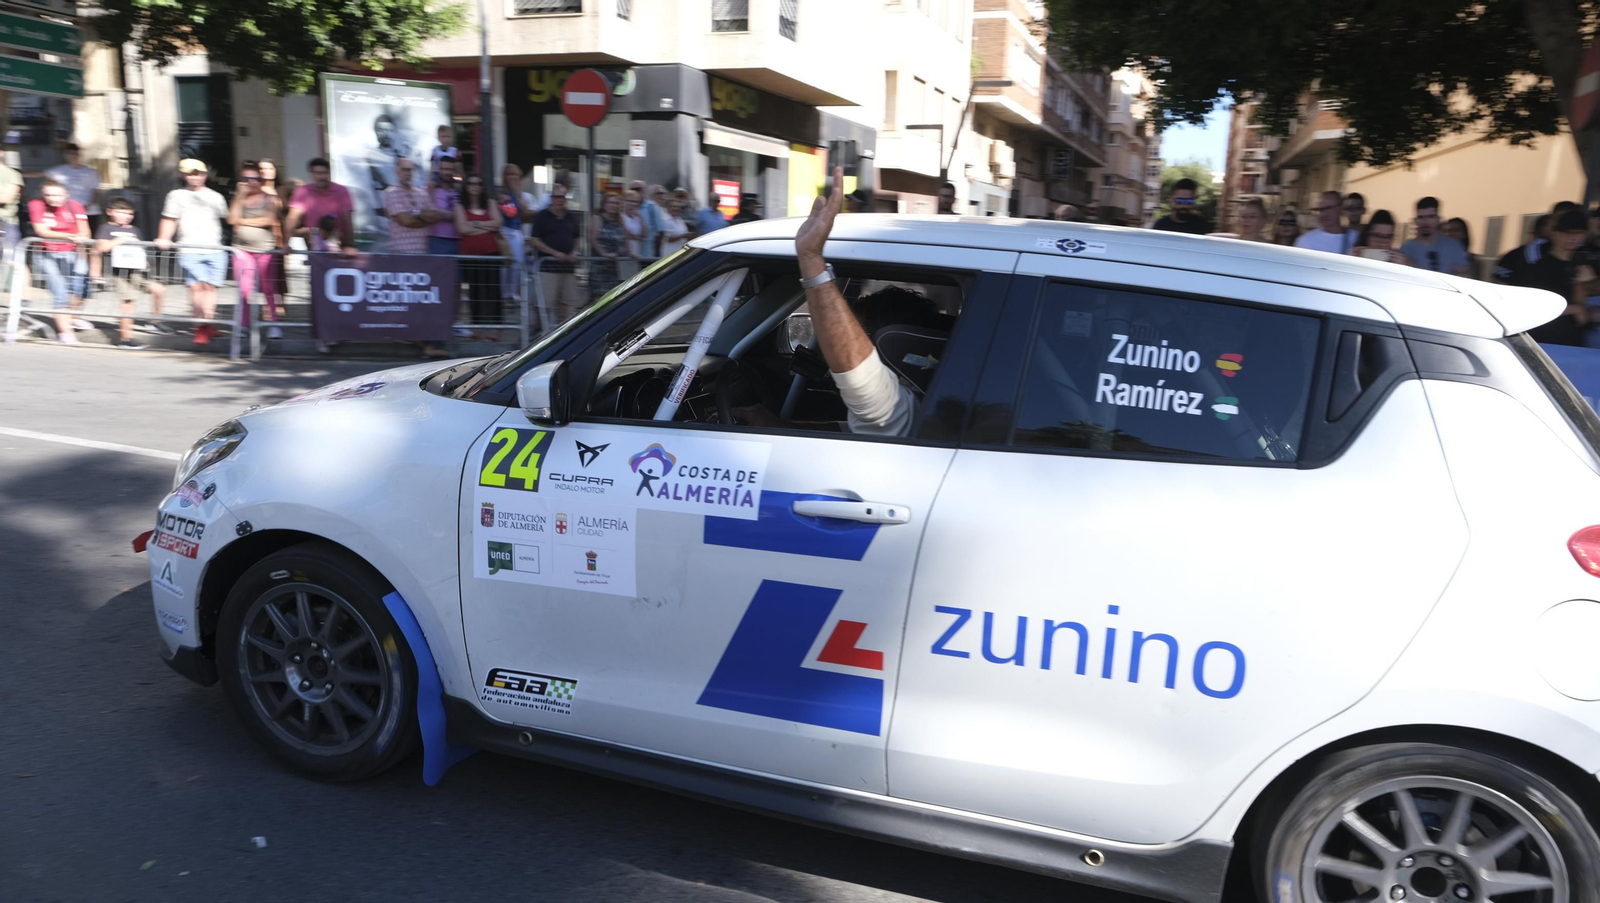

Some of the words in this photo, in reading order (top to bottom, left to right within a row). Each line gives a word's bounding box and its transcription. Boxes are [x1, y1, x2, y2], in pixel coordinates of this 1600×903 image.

[365, 271, 431, 290] grupo
[366, 286, 442, 304] control
[1107, 333, 1201, 373] Zunino
[1095, 373, 1204, 416] Ramírez
[480, 428, 547, 490] 24
[549, 473, 614, 487] CUPRA
[678, 465, 731, 482] COSTA
[735, 470, 758, 484] DE
[554, 483, 580, 492] INDALO
[580, 486, 606, 495] MOTOR
[656, 481, 754, 508] ALMERÍA
[157, 511, 206, 540] MOTOR
[498, 511, 547, 524] DIPUTACIÓN
[498, 520, 509, 528] DE
[510, 522, 545, 532] ALMERÍA
[577, 516, 630, 532] ALMERÍA
[576, 527, 604, 537] CIUDAD
[159, 534, 196, 557] SPORT
[931, 604, 1246, 700] zunino
[496, 698, 571, 715] automovilismo
[532, 696, 571, 709] andaluza
